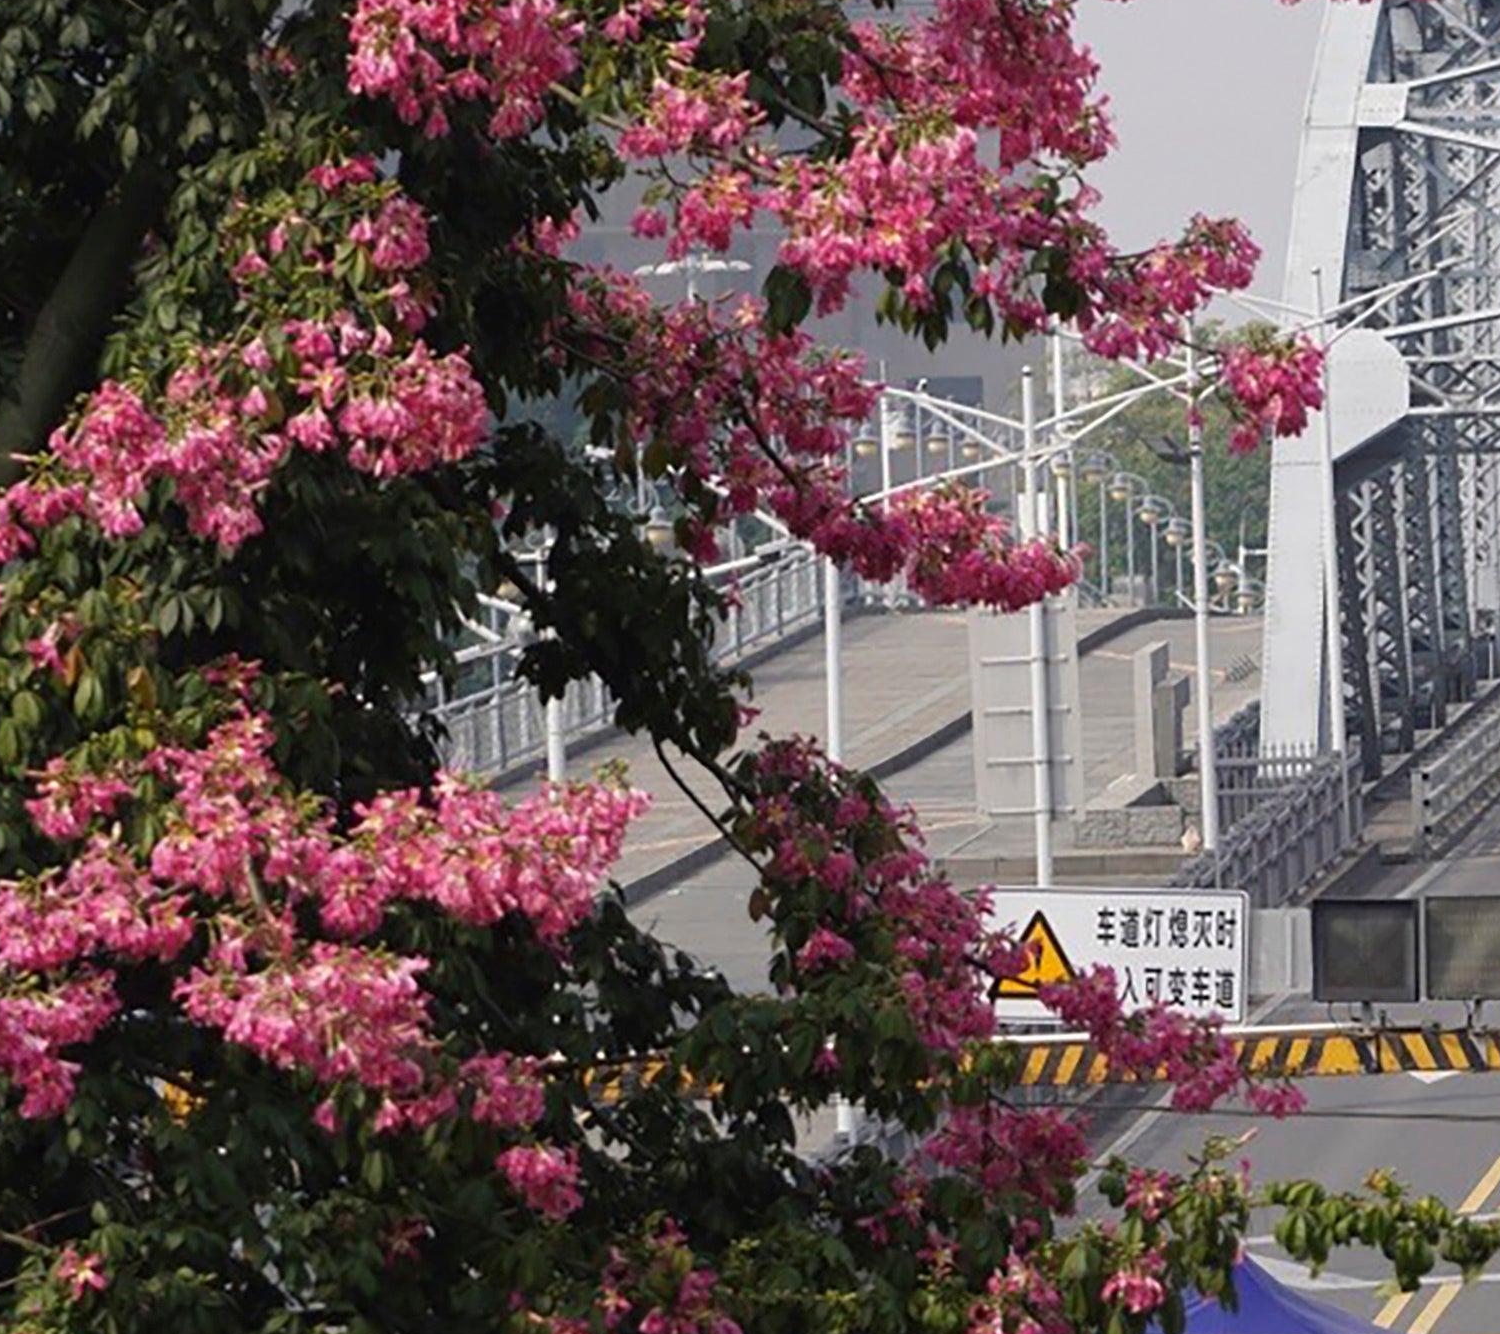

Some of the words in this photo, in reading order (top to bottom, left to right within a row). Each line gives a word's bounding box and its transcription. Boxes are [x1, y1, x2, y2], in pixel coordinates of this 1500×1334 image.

[1097, 907, 1238, 949] 车道灯熄灭时
